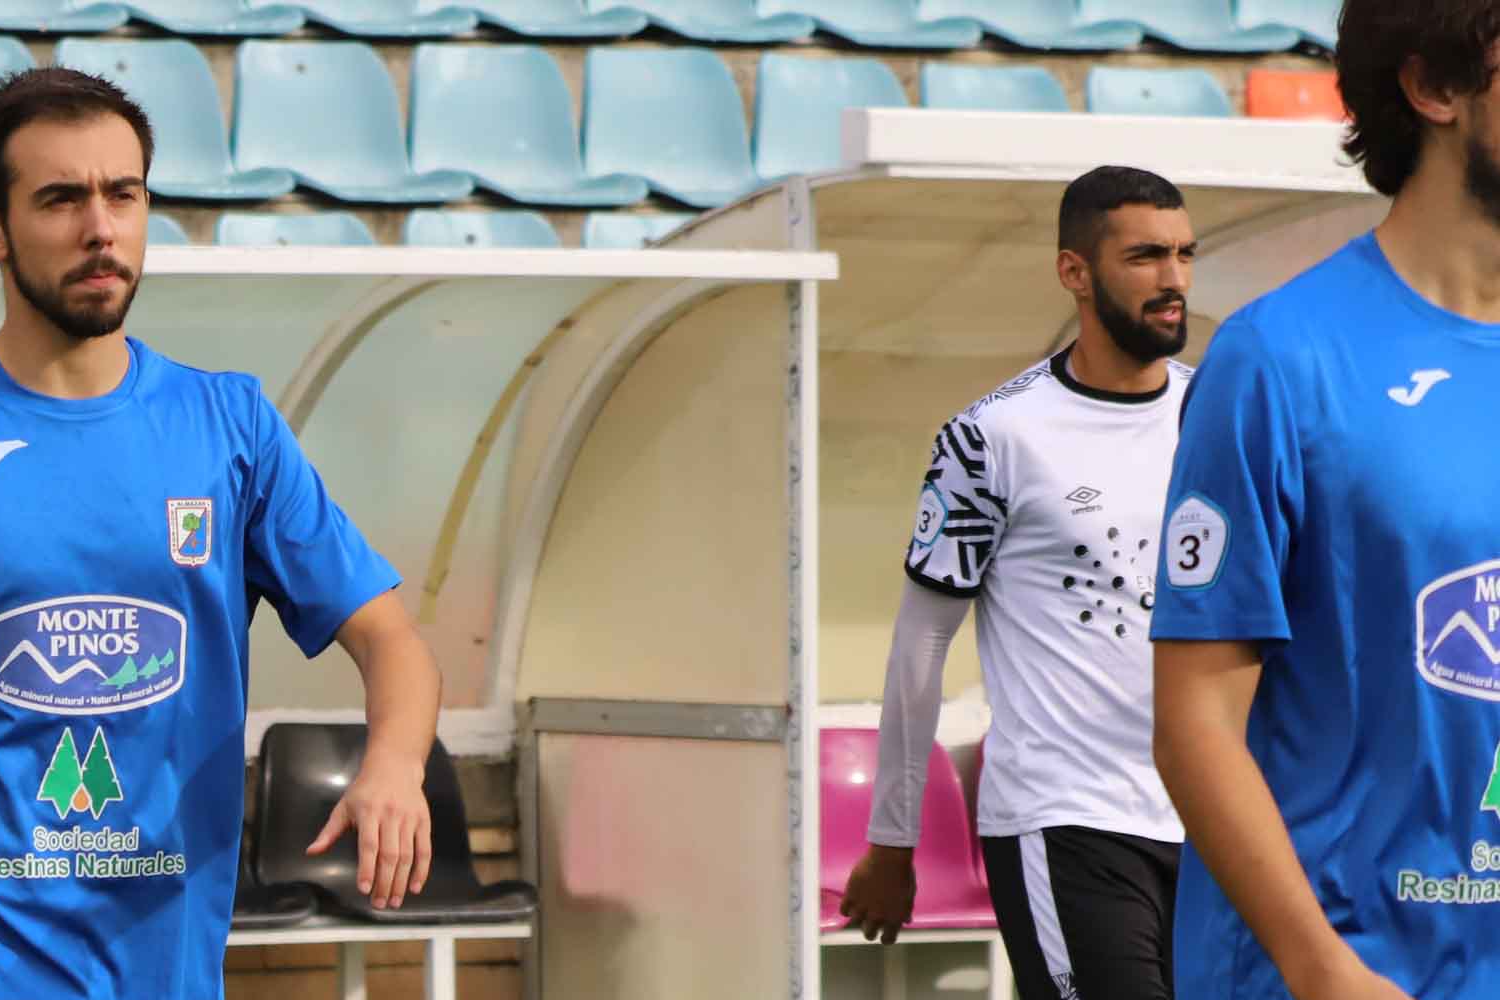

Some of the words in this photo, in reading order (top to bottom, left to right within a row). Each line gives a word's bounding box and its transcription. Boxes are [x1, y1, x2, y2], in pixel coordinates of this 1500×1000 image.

[1475, 574, 1500, 603] M
[37, 607, 140, 633] MONTE
[50, 632, 140, 657] PINOS
[20, 688, 53, 703] mineral
[54, 694, 85, 706] natural
[91, 692, 121, 706] Natural
[122, 684, 153, 701] mineral
[154, 675, 174, 692] water
[33, 826, 140, 851] Sociedad
[75, 851, 186, 879] Naturales
[1397, 870, 1500, 904] Resina
